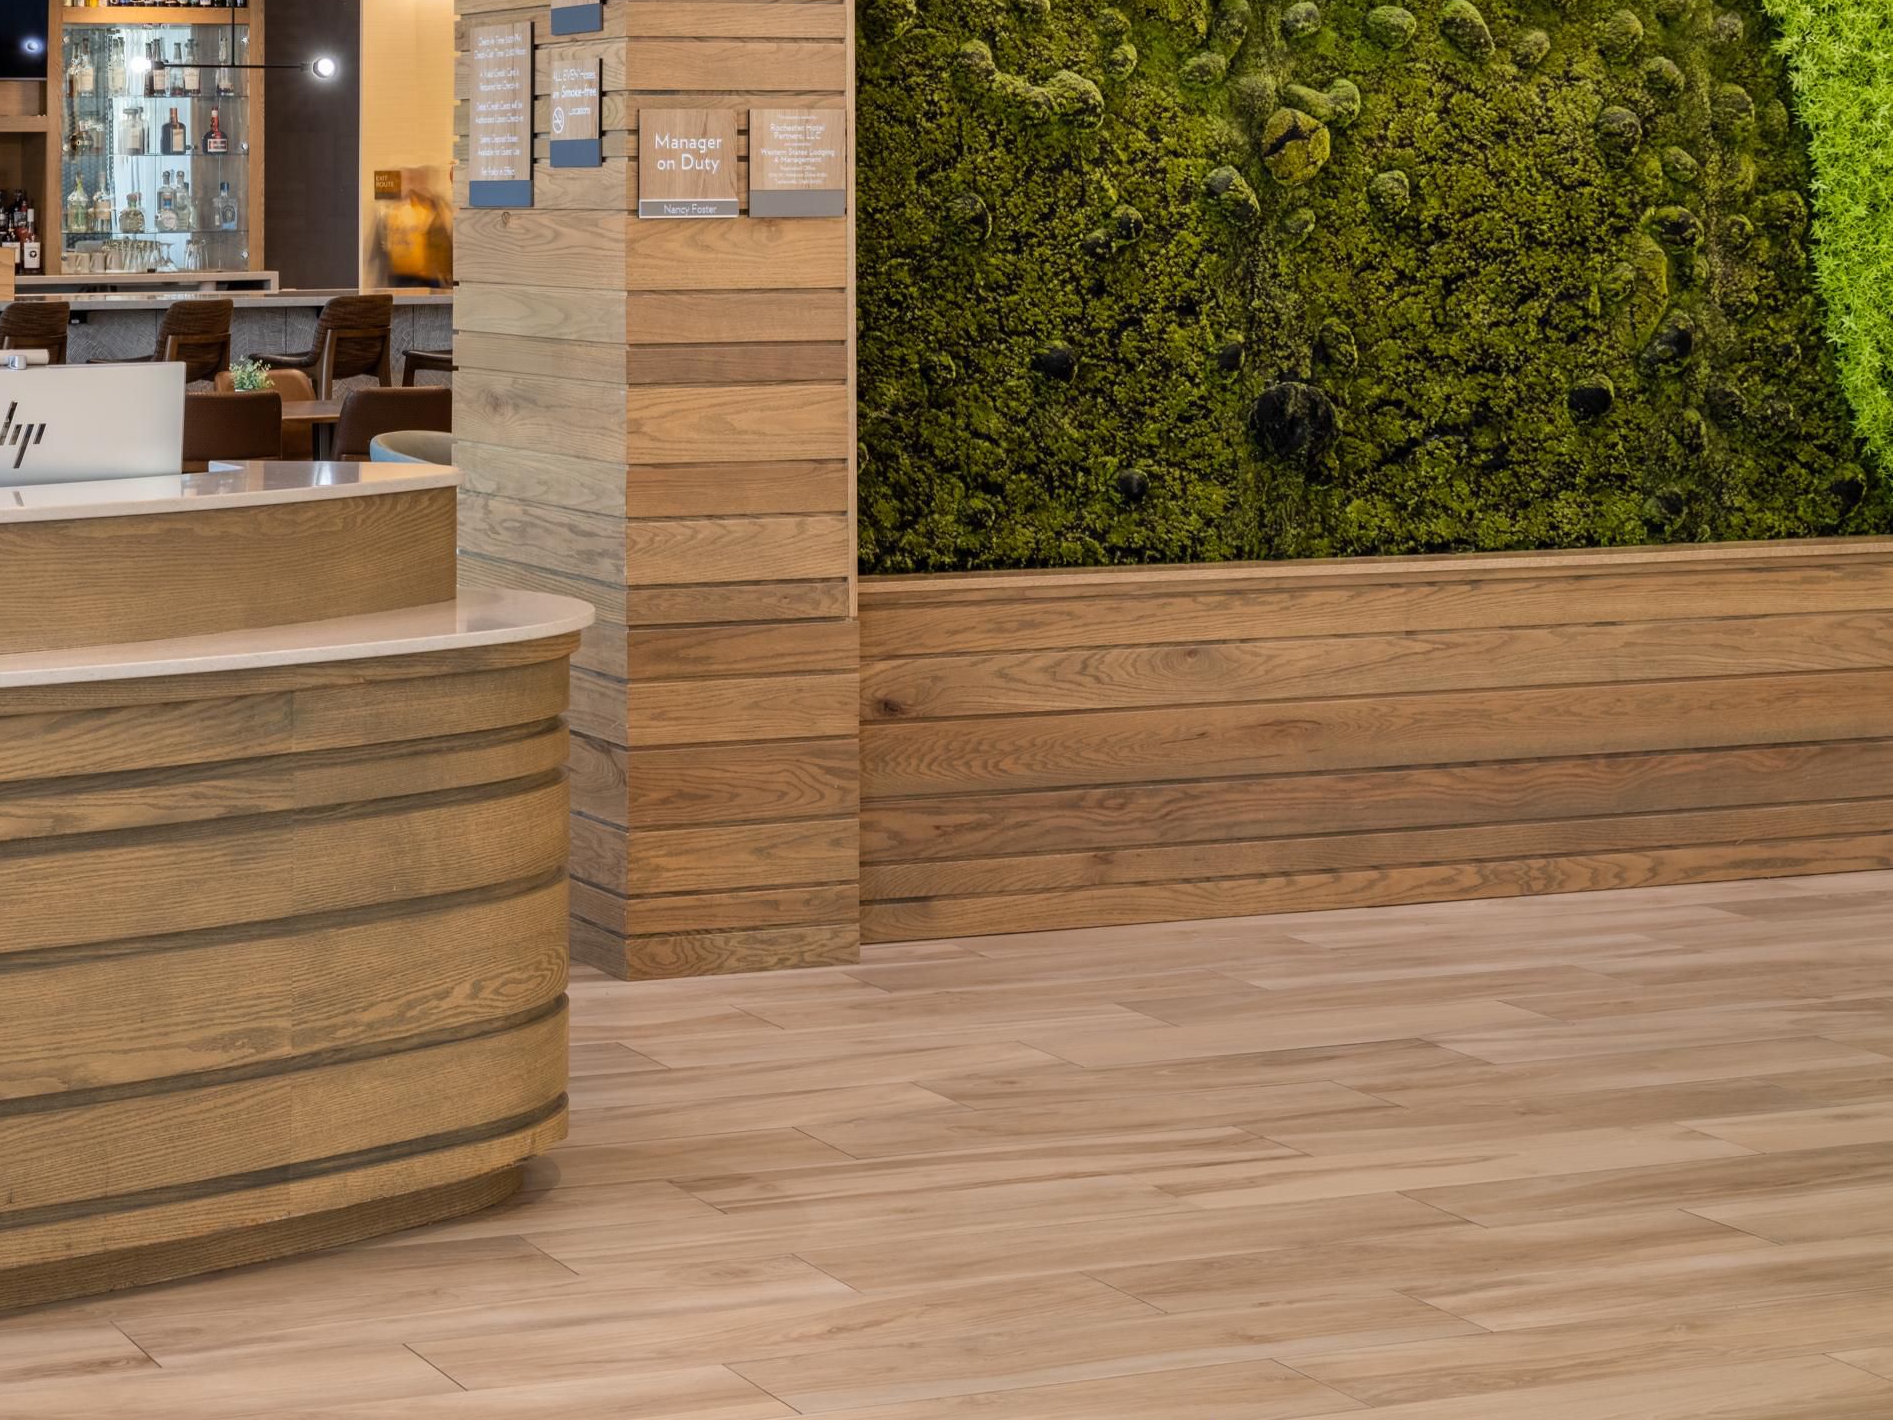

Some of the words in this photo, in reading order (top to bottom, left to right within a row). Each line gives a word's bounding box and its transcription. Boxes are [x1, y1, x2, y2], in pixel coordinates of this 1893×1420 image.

[654, 131, 722, 153] Manager
[657, 159, 675, 170] on
[681, 153, 720, 175] Duty
[664, 204, 690, 217] Nancy
[692, 203, 717, 214] Foster
